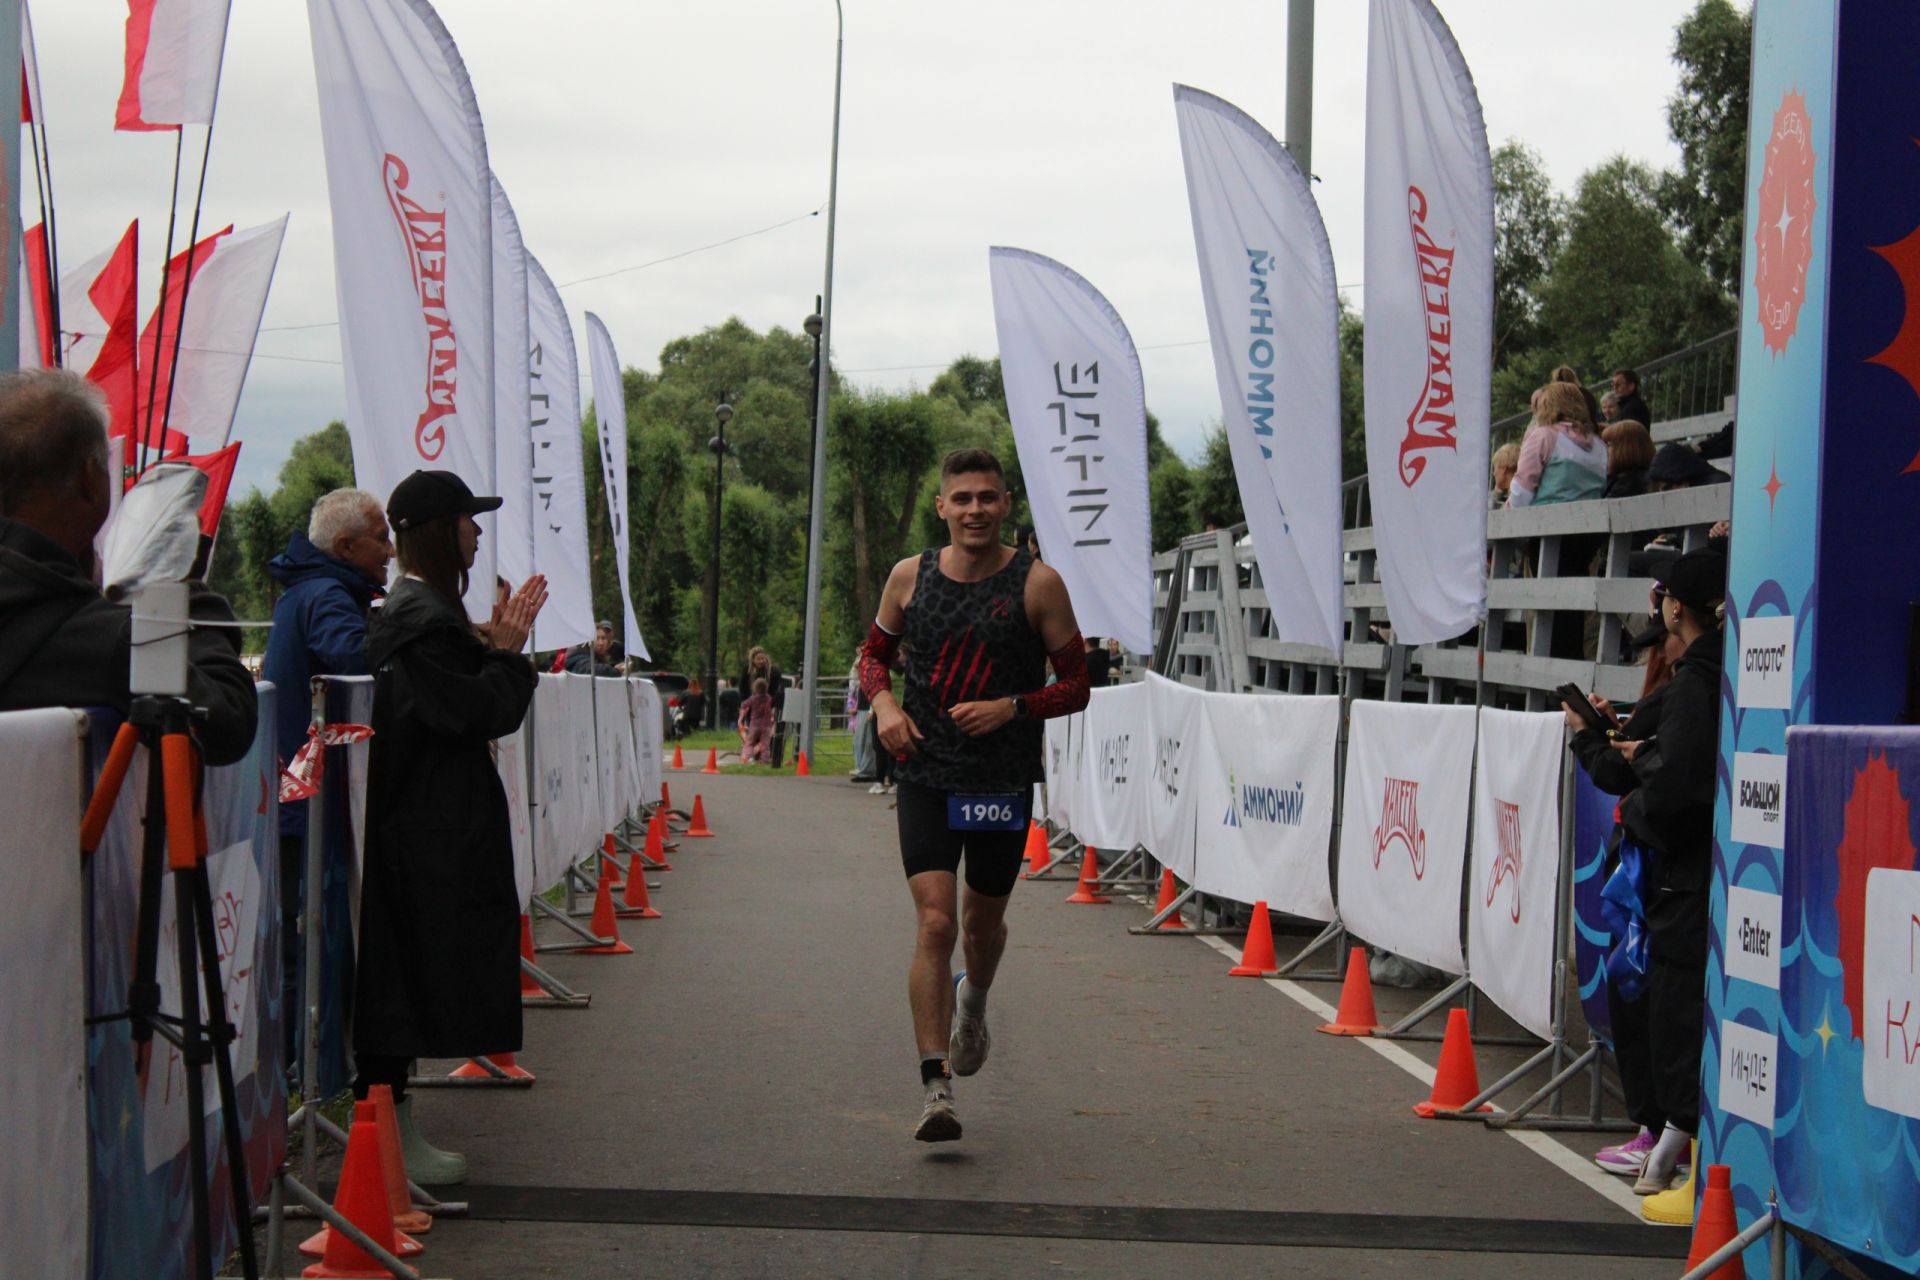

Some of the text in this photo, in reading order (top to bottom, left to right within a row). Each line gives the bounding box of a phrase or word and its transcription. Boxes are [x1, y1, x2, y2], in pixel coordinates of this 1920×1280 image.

[960, 804, 1013, 822] 1906
[1242, 781, 1304, 827] АММОНИЙ
[1740, 779, 1780, 811] БОЛЬШОЙ
[1743, 917, 1771, 957] Enter
